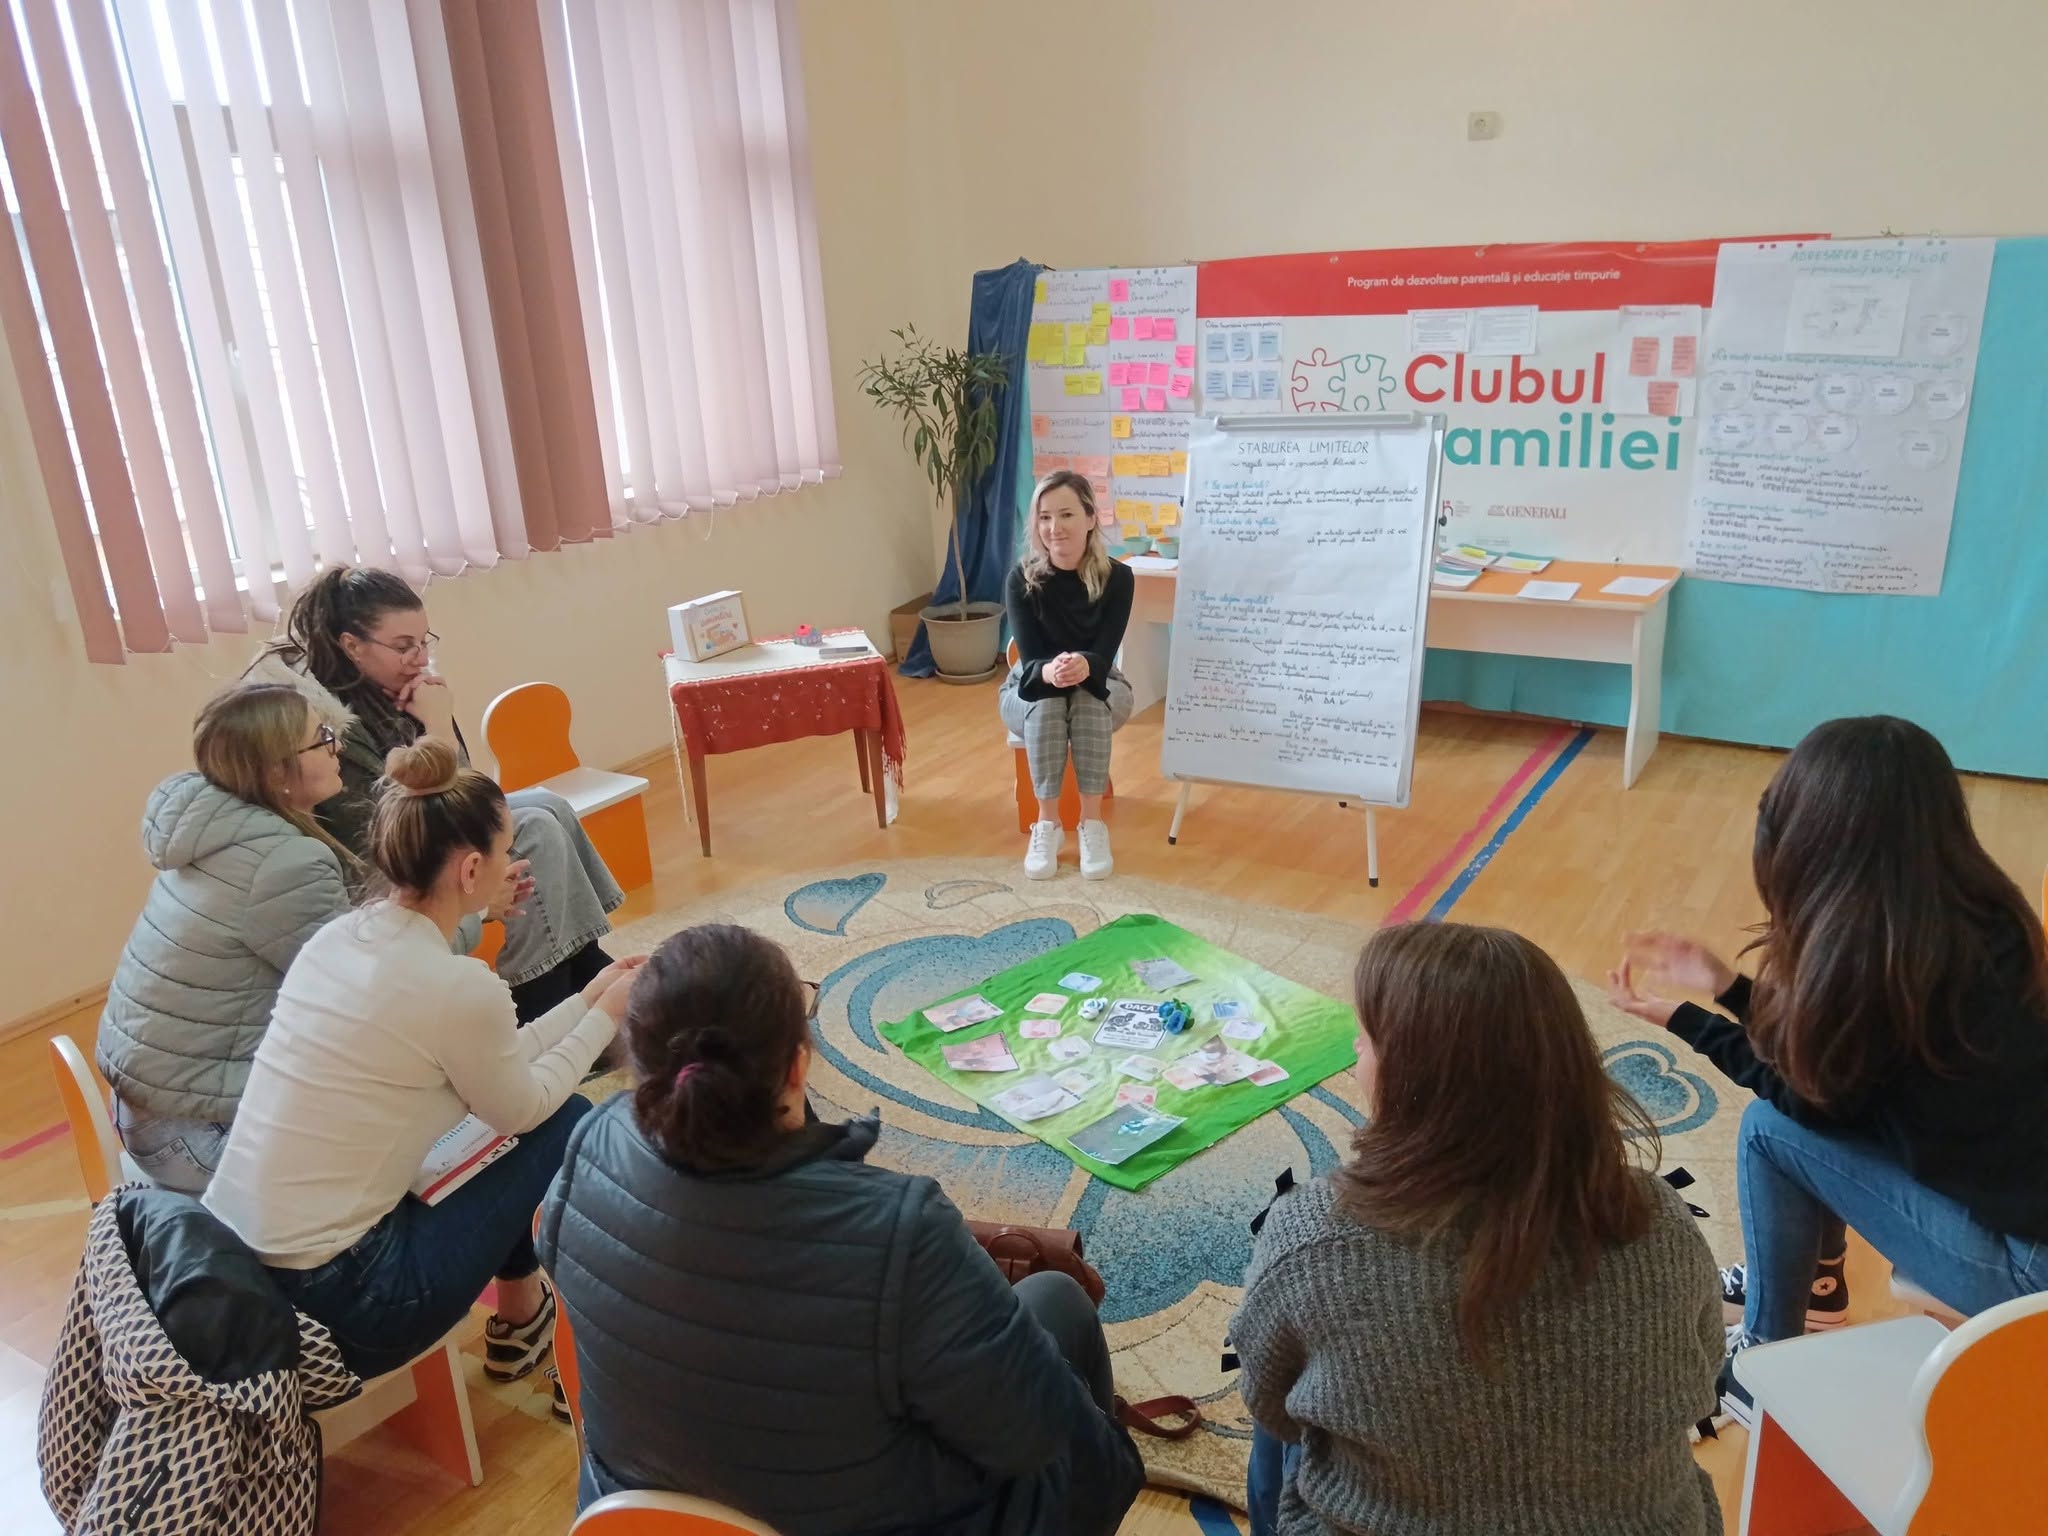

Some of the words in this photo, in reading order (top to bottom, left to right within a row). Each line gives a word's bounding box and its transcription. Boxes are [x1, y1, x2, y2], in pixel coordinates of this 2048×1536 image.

[1347, 276, 1389, 290] Program
[1391, 275, 1405, 287] de
[1407, 274, 1459, 287] dezvoltare
[1461, 272, 1511, 287] parentală
[1524, 270, 1571, 285] educație
[1574, 268, 1621, 281] timpurie
[1404, 352, 1606, 404] Clubul
[1238, 442, 1300, 454] STABILIREA
[1309, 440, 1369, 454] LIMITELOR
[1444, 412, 1683, 471] amiliei
[1506, 505, 1567, 520] GENERALI
